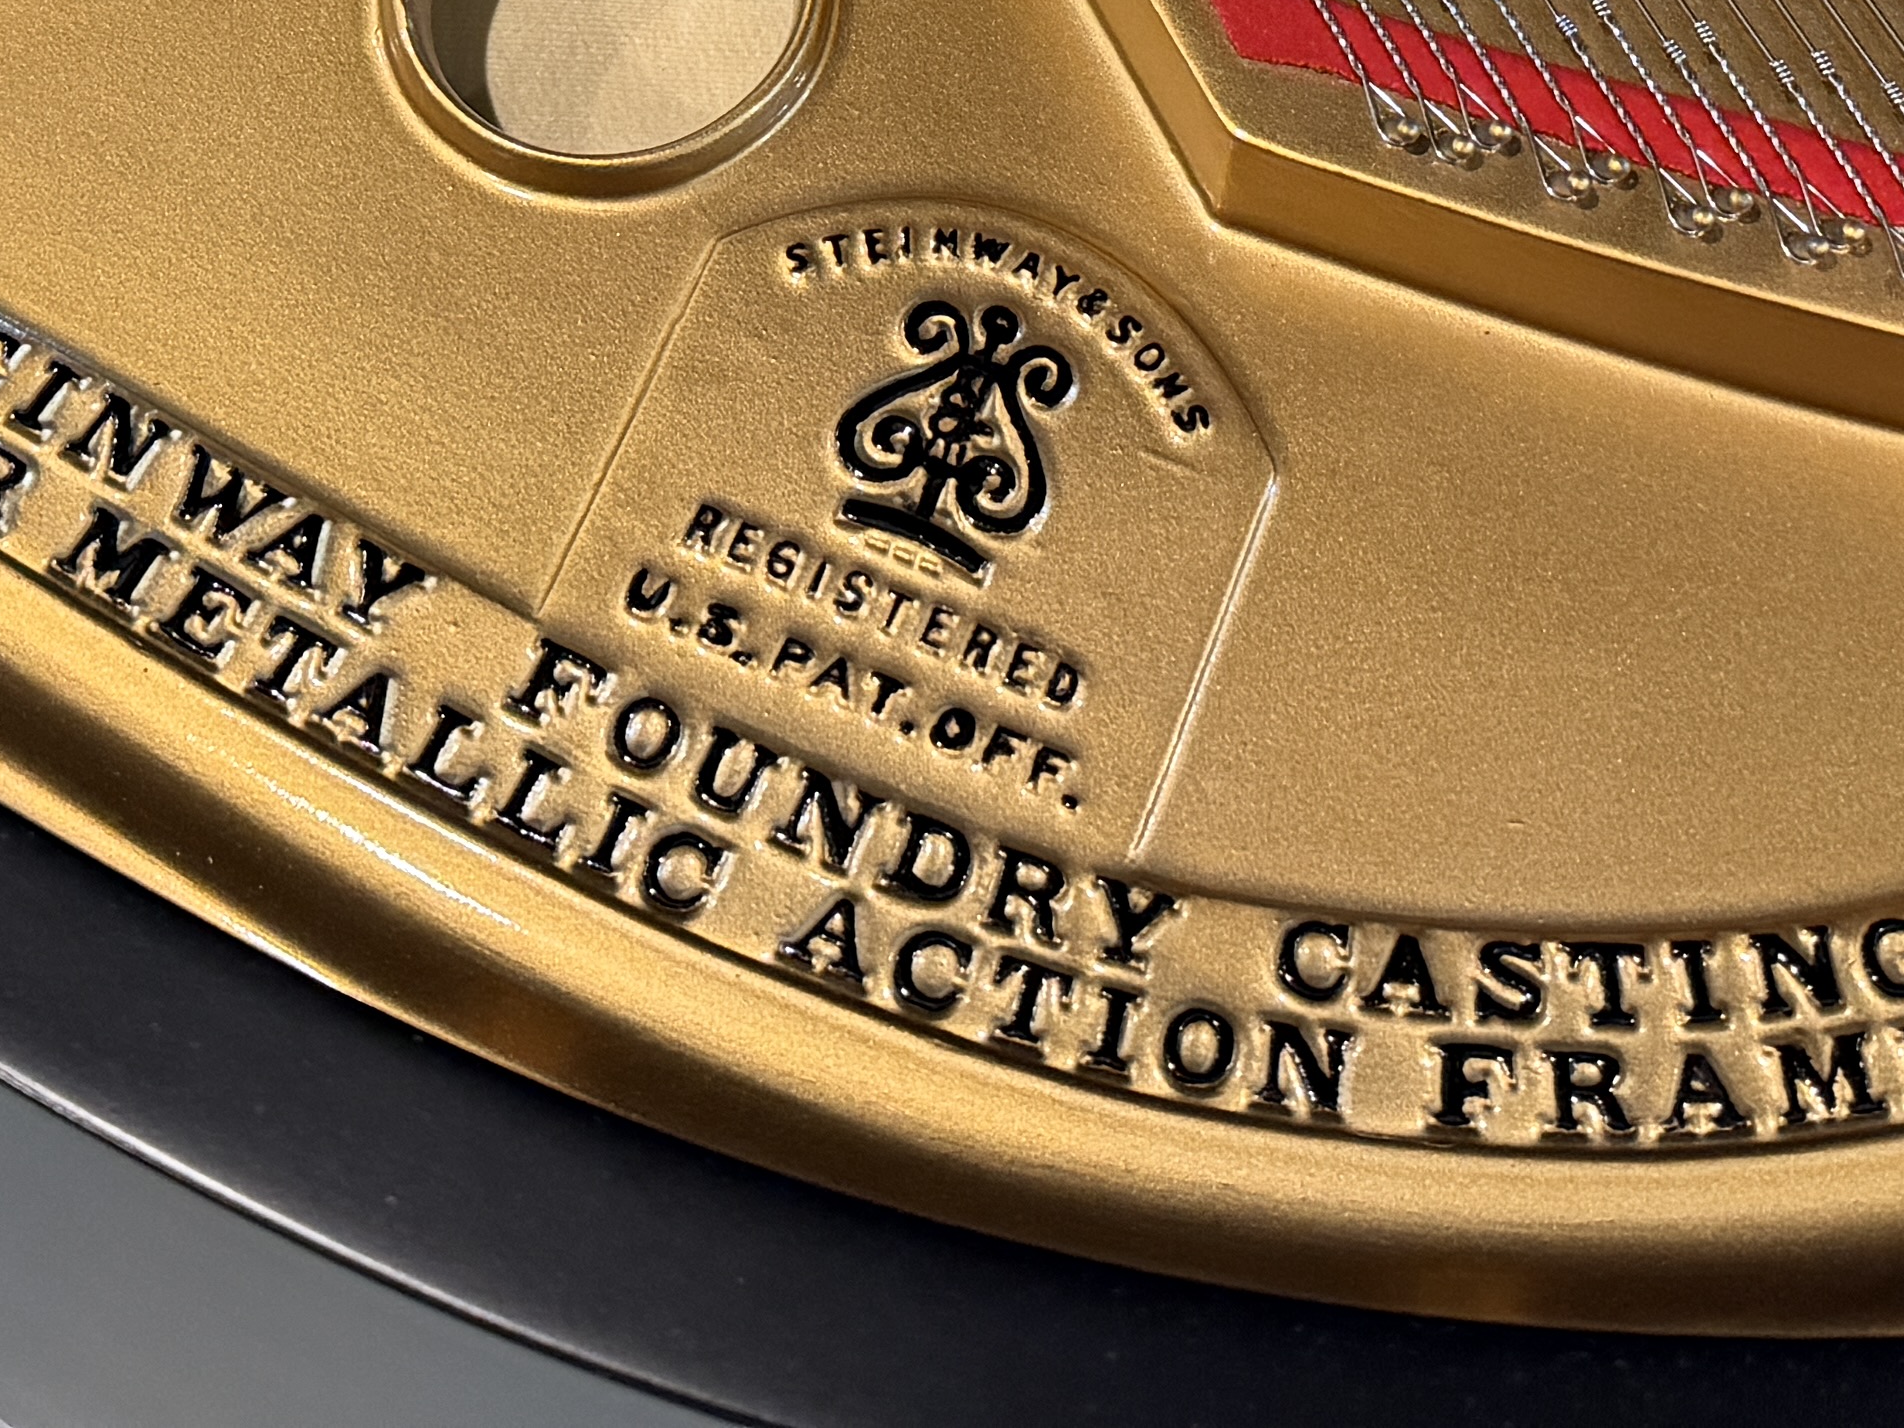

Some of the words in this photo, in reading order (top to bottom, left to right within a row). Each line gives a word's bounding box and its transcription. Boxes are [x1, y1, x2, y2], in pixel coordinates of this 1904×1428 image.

[684, 503, 1081, 710] REGISTERED
[51, 504, 724, 911] METALLIC
[777, 896, 1355, 1116] ACTION
[505, 638, 1182, 967] FOUNDRY
